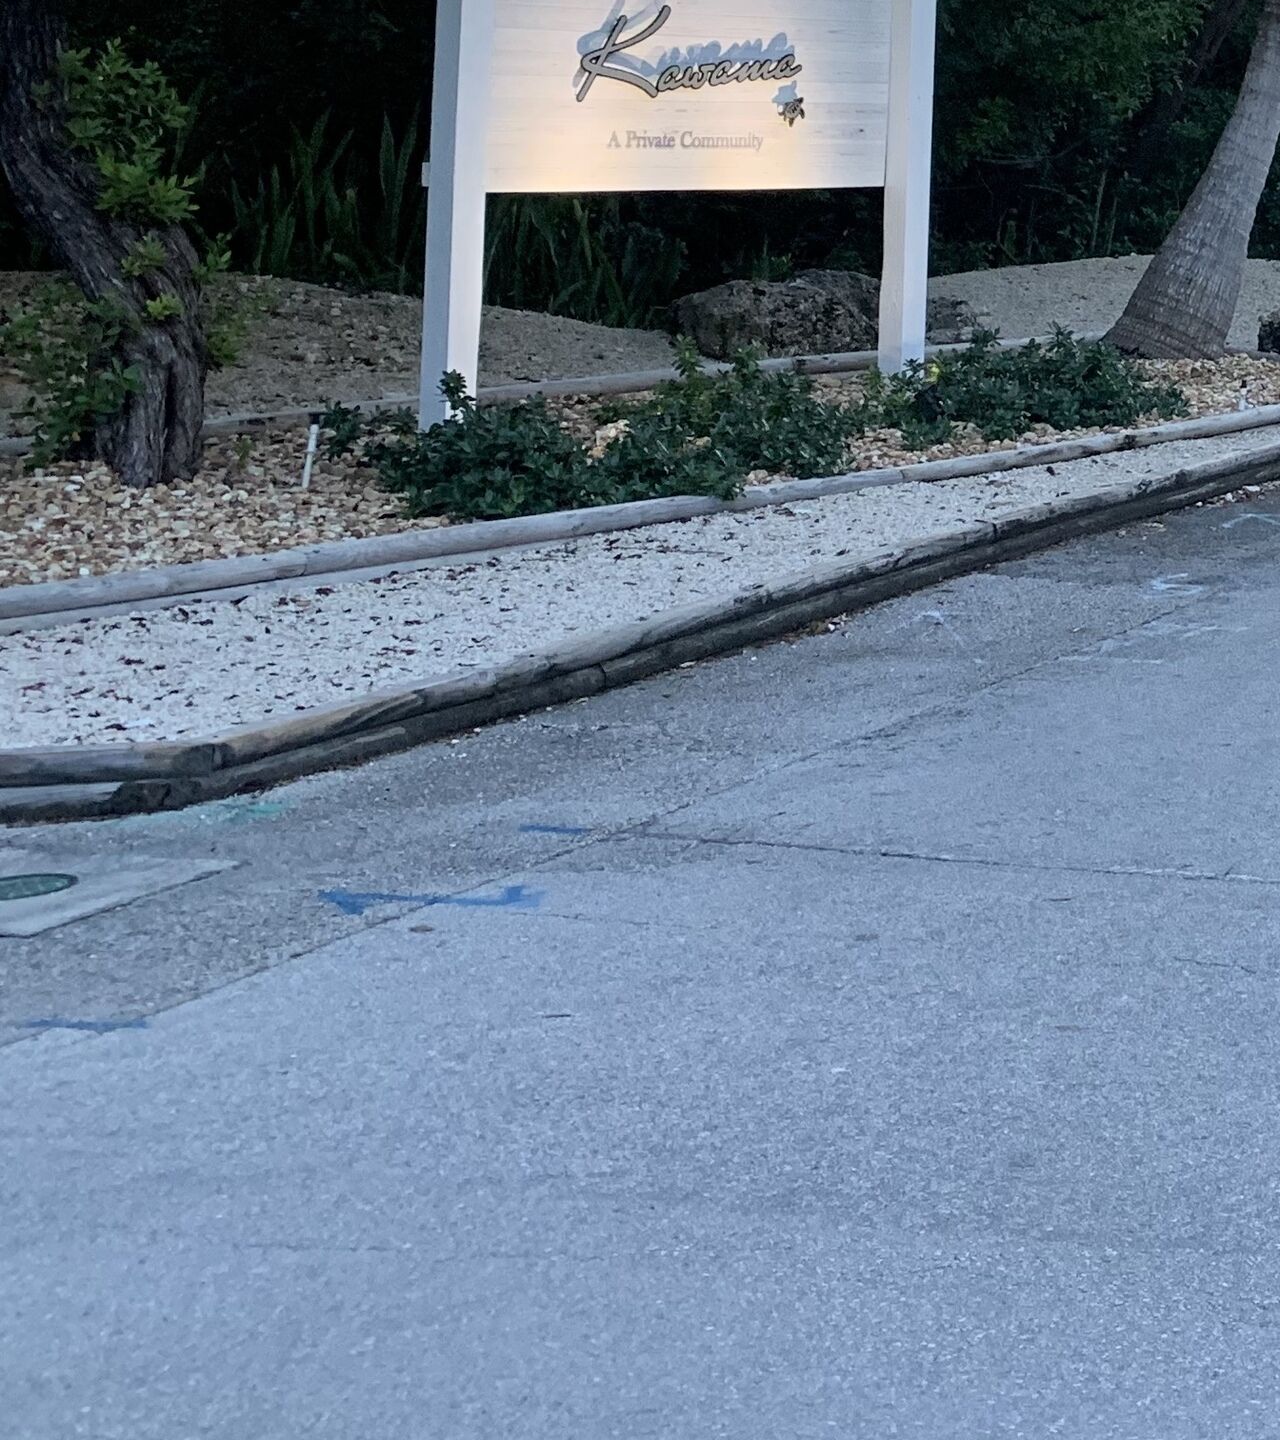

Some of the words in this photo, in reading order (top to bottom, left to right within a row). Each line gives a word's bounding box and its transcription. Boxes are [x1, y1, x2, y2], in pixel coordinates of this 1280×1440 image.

[576, 5, 802, 102] Kawama
[607, 130, 621, 148] A
[625, 130, 675, 148] Private
[680, 131, 764, 152] Community
